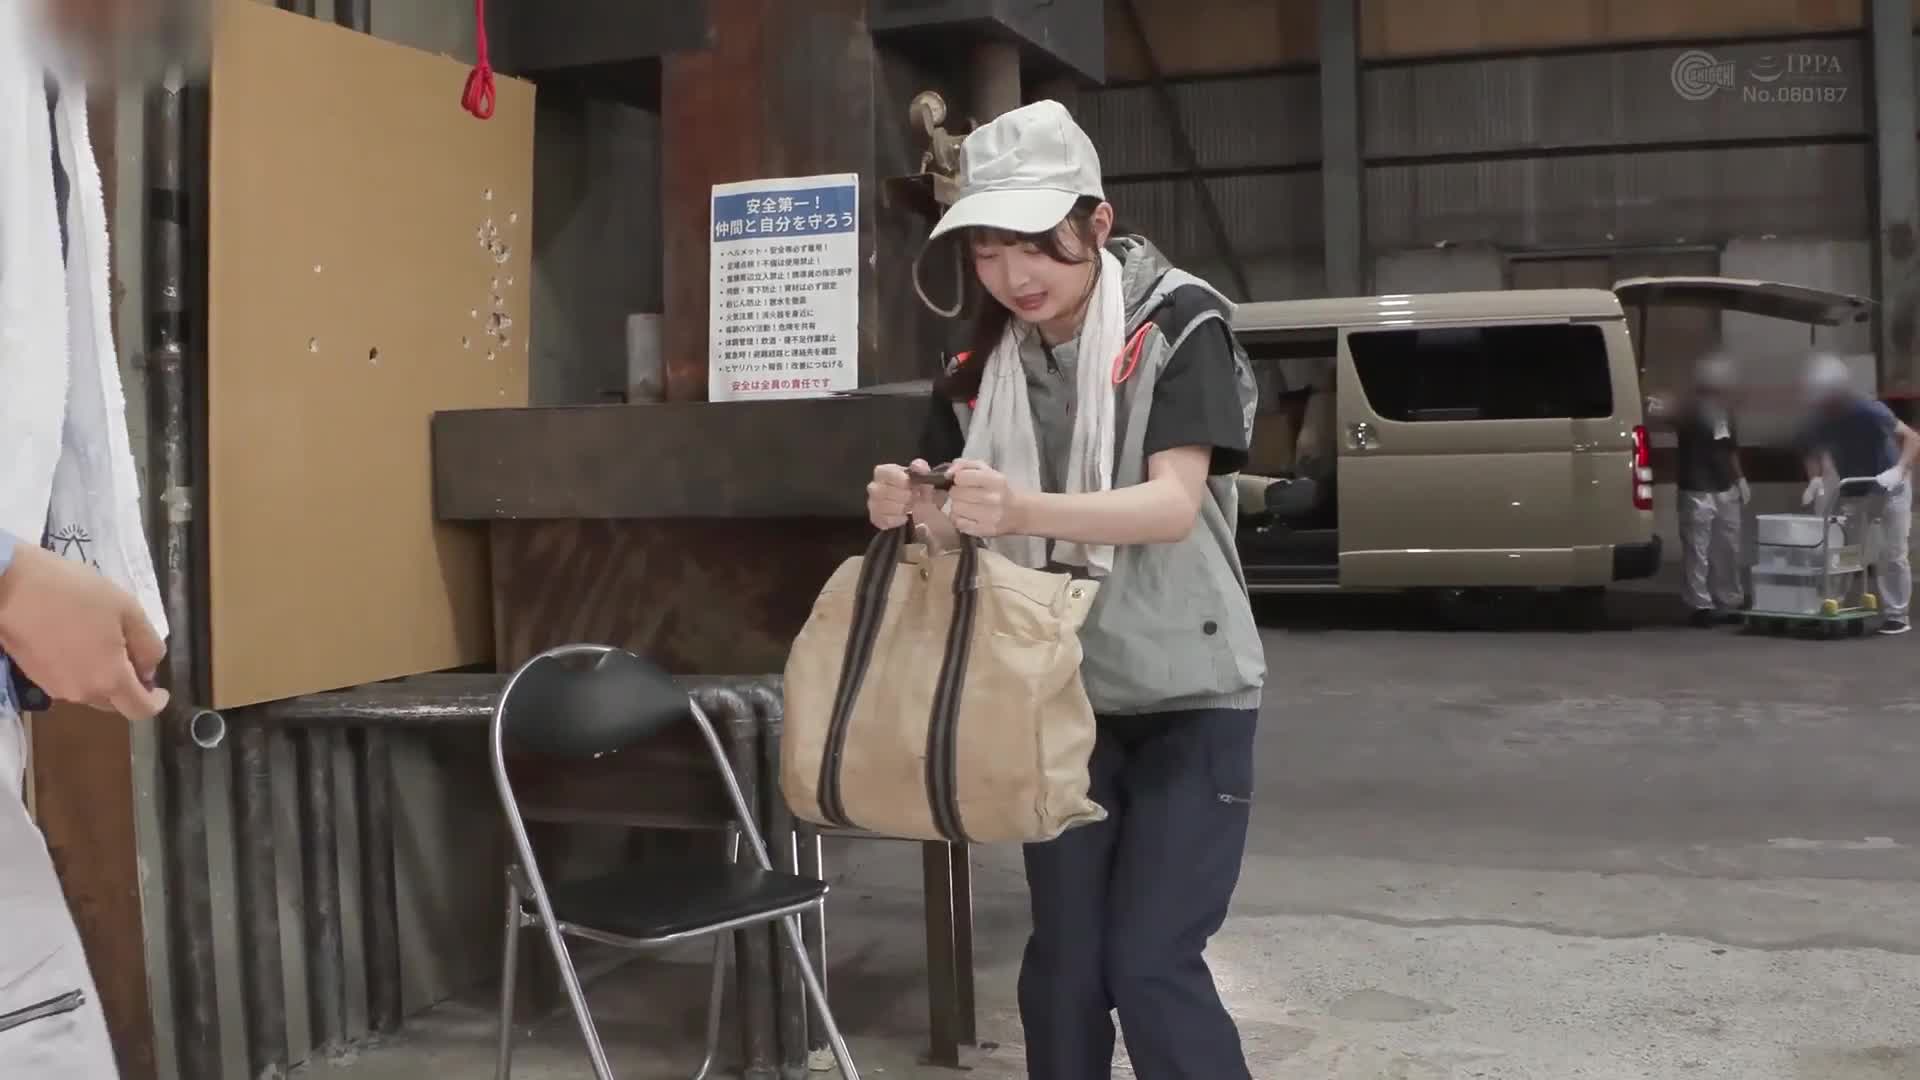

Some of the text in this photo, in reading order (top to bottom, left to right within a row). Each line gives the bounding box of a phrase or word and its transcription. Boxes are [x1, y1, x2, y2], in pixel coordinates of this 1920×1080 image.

[747, 195, 820, 214] 安全第一！
[715, 212, 853, 237] 仲間と自分を守ろう
[731, 377, 832, 392] 安全は全員の責任です
